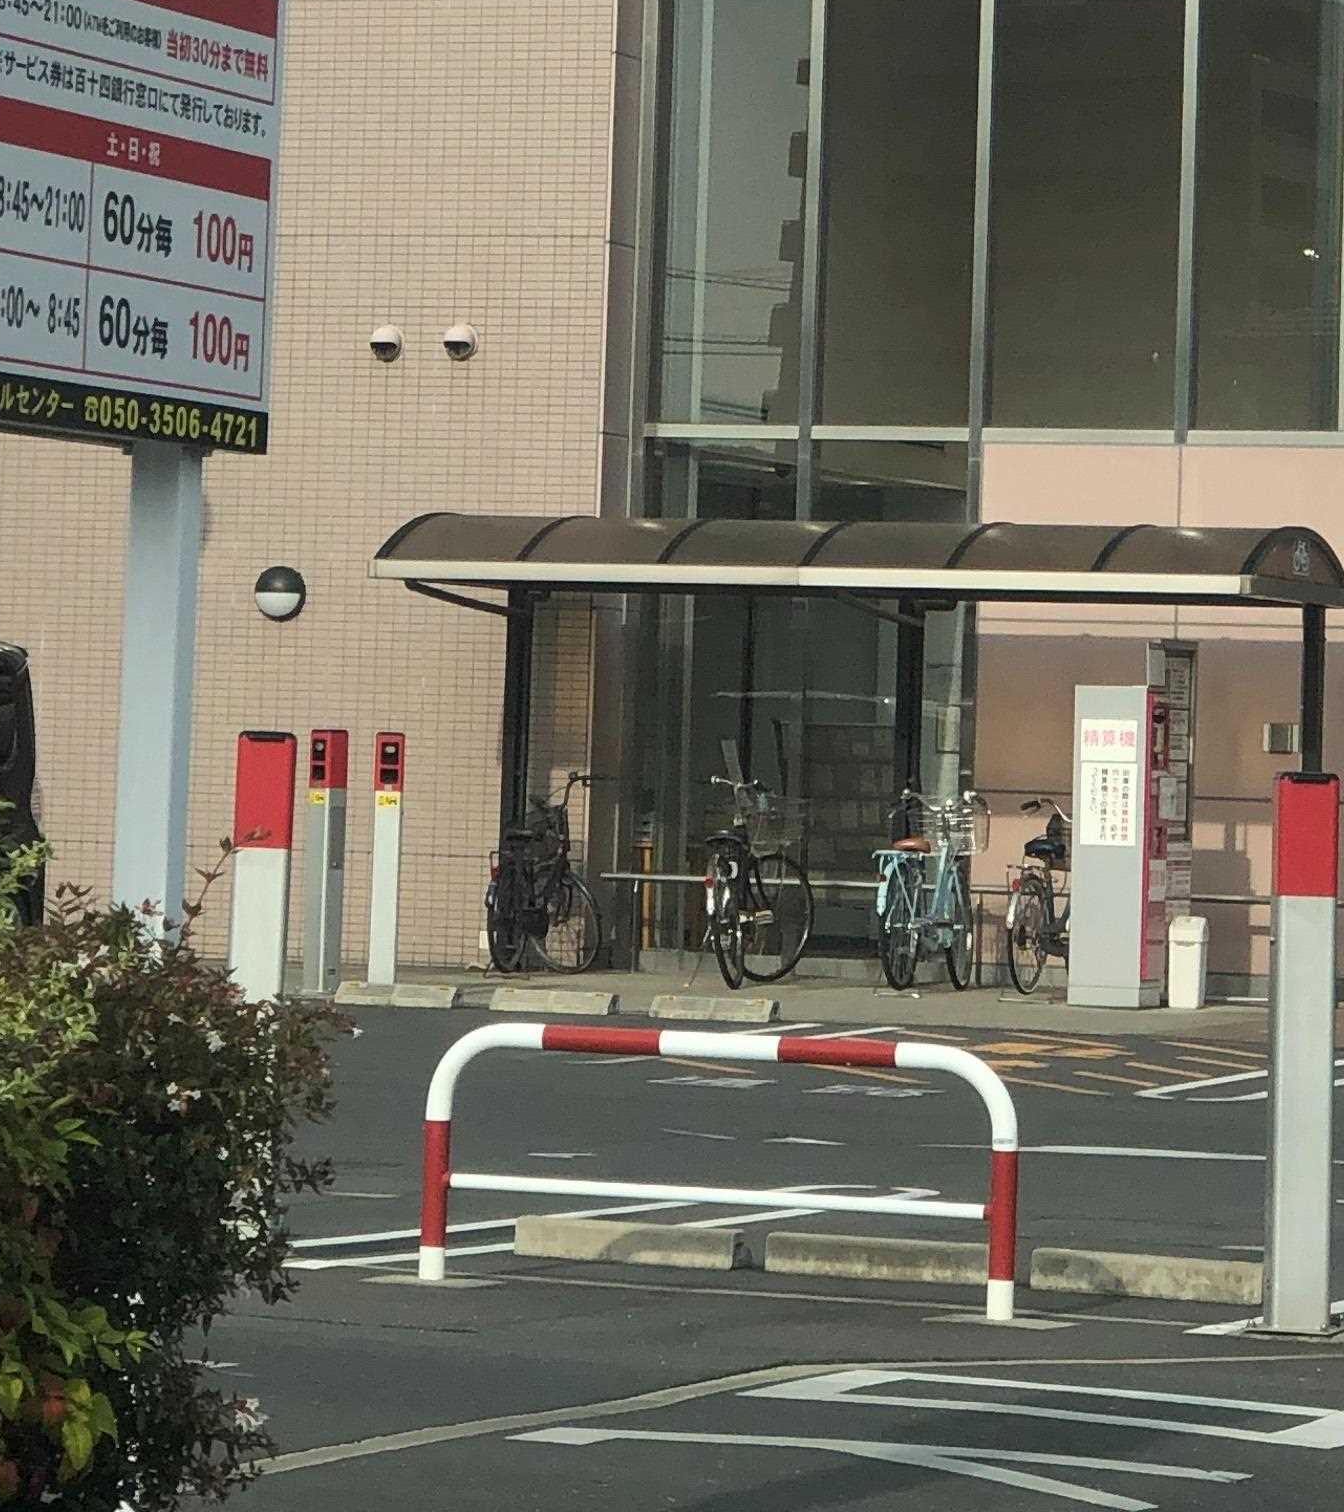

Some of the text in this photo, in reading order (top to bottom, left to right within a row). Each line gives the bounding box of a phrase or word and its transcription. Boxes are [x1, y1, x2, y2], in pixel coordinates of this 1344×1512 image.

[101, 188, 174, 260] 60分毎
[191, 208, 255, 274] 100円
[96, 293, 170, 361] 60分毎
[187, 308, 251, 372] 100円
